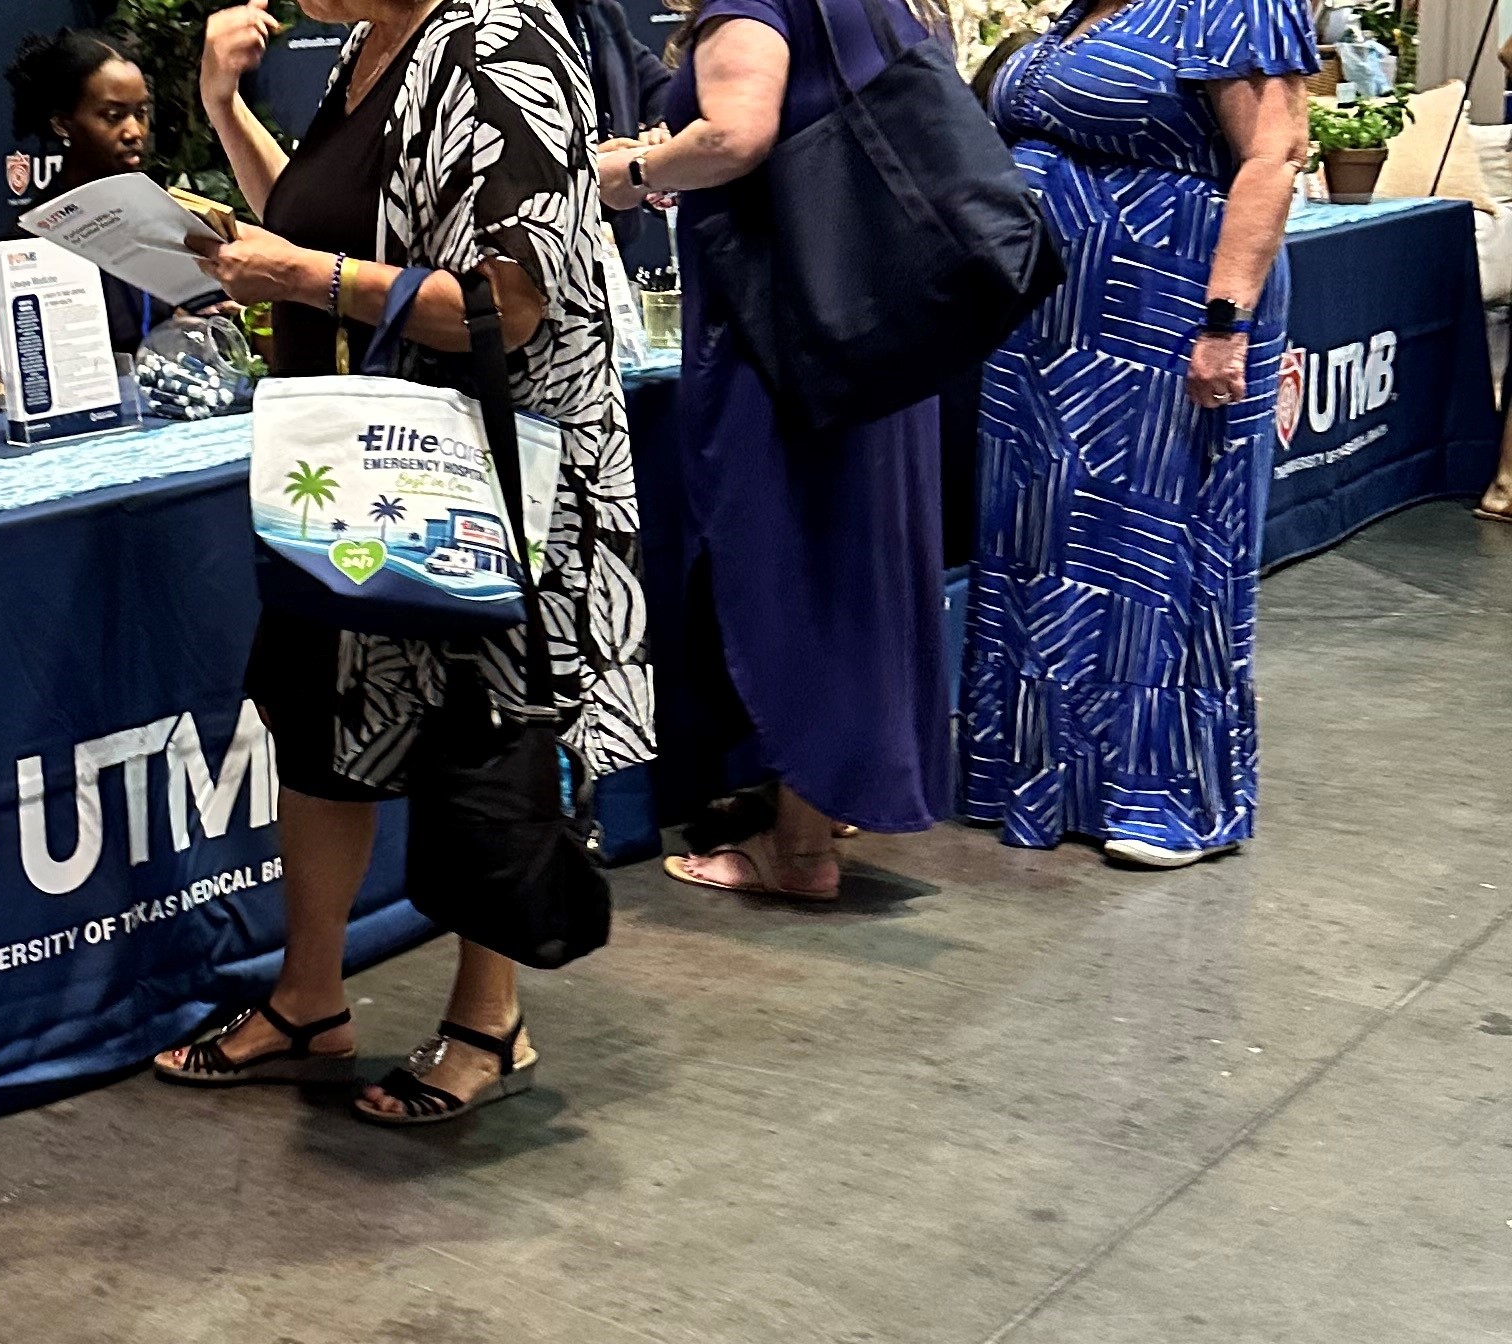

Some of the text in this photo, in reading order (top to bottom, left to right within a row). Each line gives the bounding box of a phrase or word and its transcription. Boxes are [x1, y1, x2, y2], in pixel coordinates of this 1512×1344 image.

[1308, 331, 1397, 433] UTMB
[363, 457, 441, 472] EMERGENCY
[16, 698, 280, 895] UTM
[83, 916, 117, 945] OF
